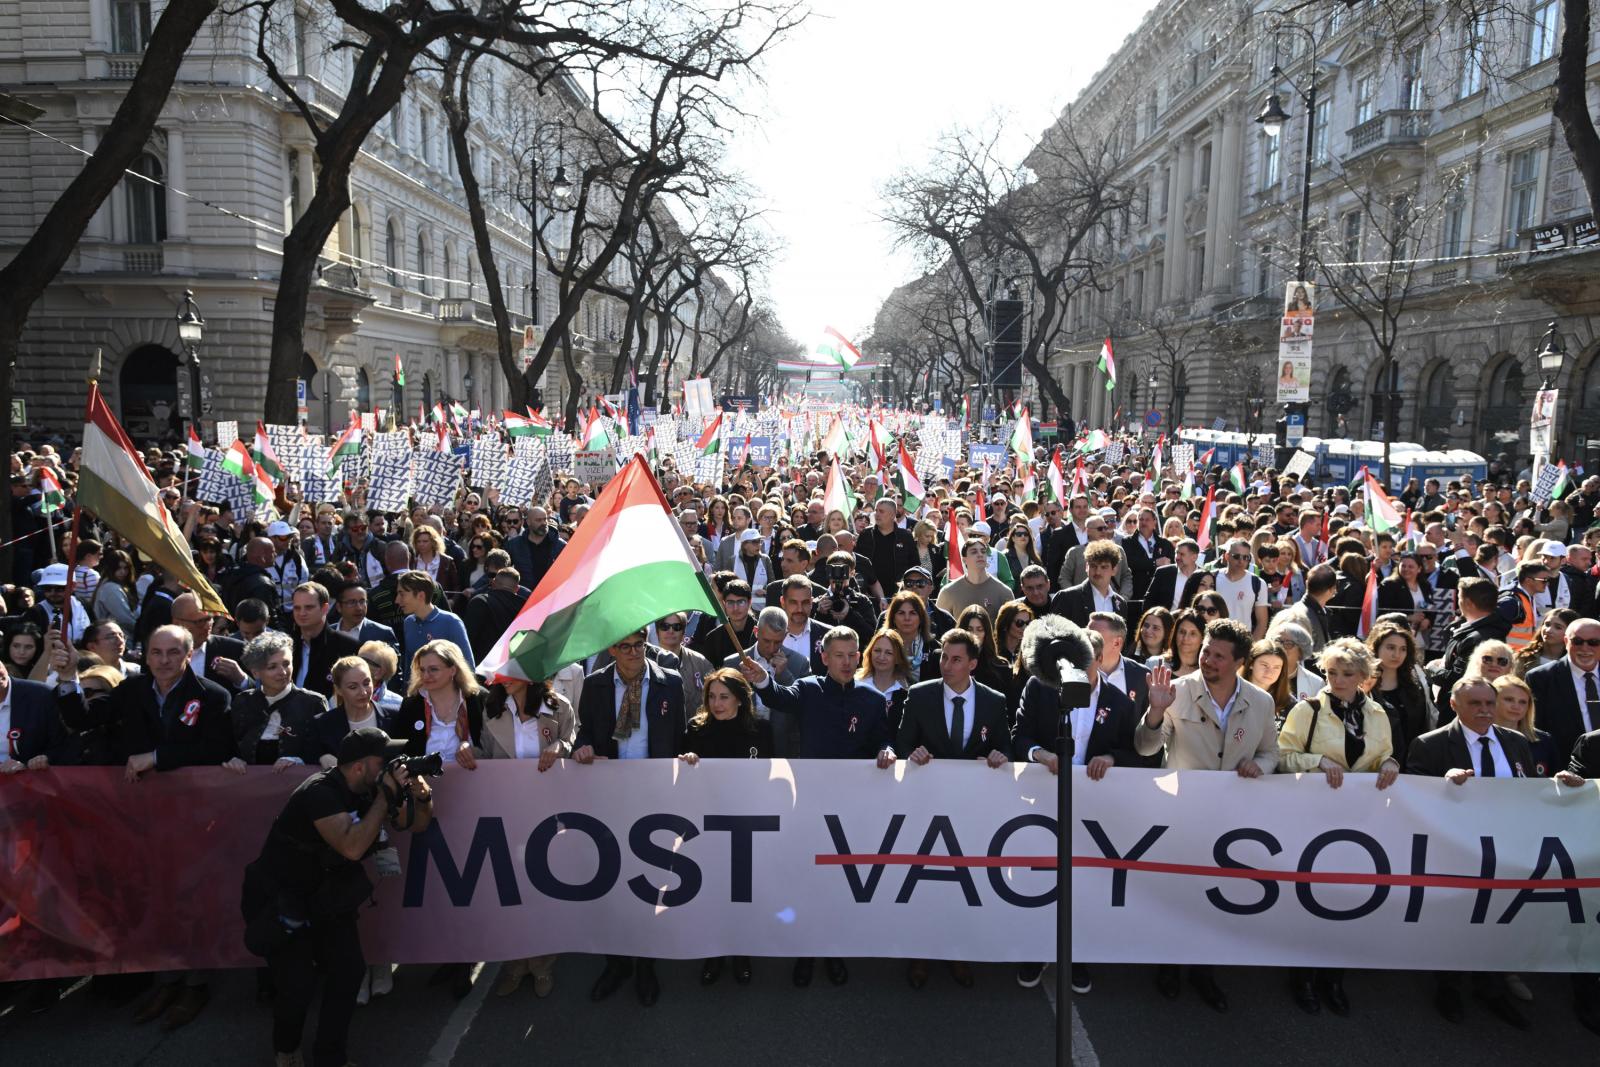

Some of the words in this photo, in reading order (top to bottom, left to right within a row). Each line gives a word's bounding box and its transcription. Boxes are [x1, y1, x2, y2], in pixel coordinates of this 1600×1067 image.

[1291, 414, 1300, 425] P
[265, 424, 304, 436] TISZA
[299, 446, 332, 458] TISZ
[472, 450, 508, 463] TISZA
[972, 451, 1002, 461] MOST
[370, 464, 411, 481] TISZA
[423, 459, 463, 478] TISZA
[471, 460, 507, 473] TISZA
[584, 466, 605, 474] VIZET
[419, 470, 461, 489] TISZA
[471, 469, 507, 483] TISZA
[197, 480, 229, 495] TISZ
[300, 480, 341, 492] TISZA
[369, 476, 410, 491] TISZA
[417, 481, 458, 500] TISZA
[195, 490, 228, 504] TISZ
[367, 487, 409, 503] TISZA
[402, 811, 780, 908] MOST
[824, 813, 1170, 908] VAGY
